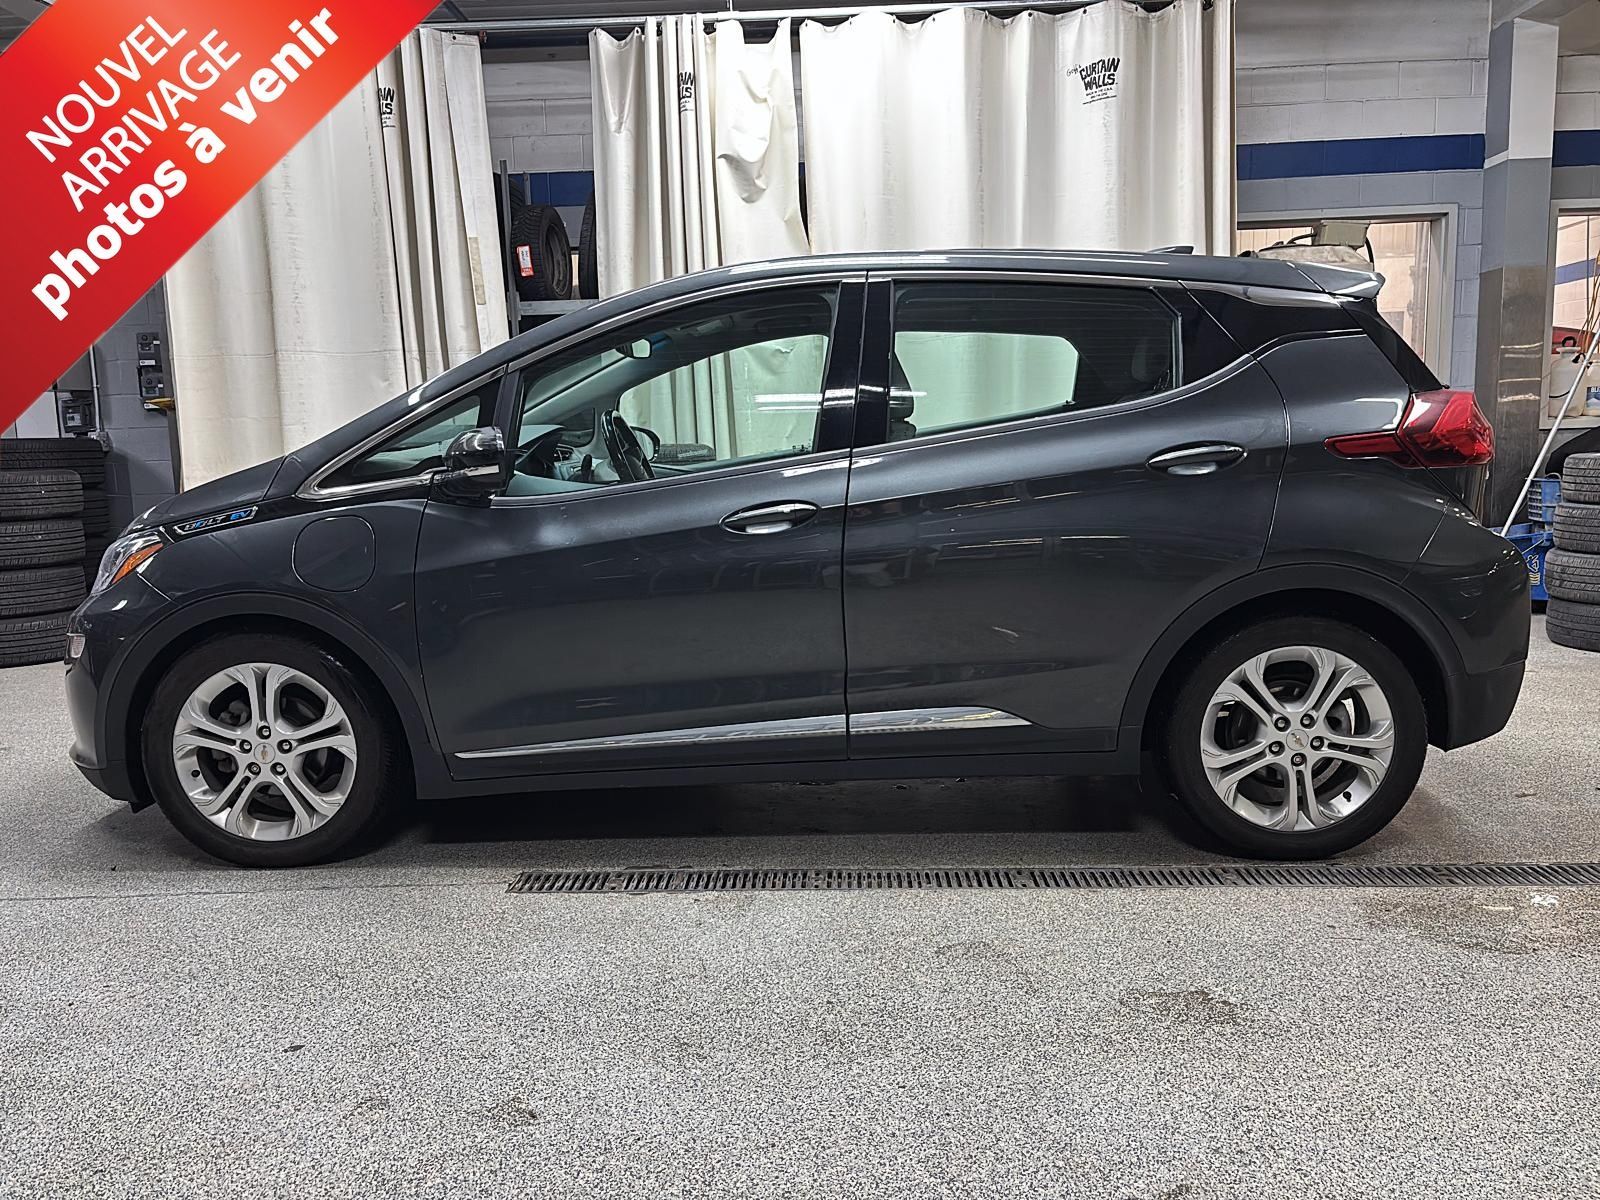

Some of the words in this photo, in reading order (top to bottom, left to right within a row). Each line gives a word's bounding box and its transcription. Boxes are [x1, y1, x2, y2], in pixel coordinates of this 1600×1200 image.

[1079, 57, 1120, 81] CURTAIN
[1083, 73, 1115, 91] WALLS
[184, 515, 227, 531] BOLT
[230, 509, 251, 520] EV
